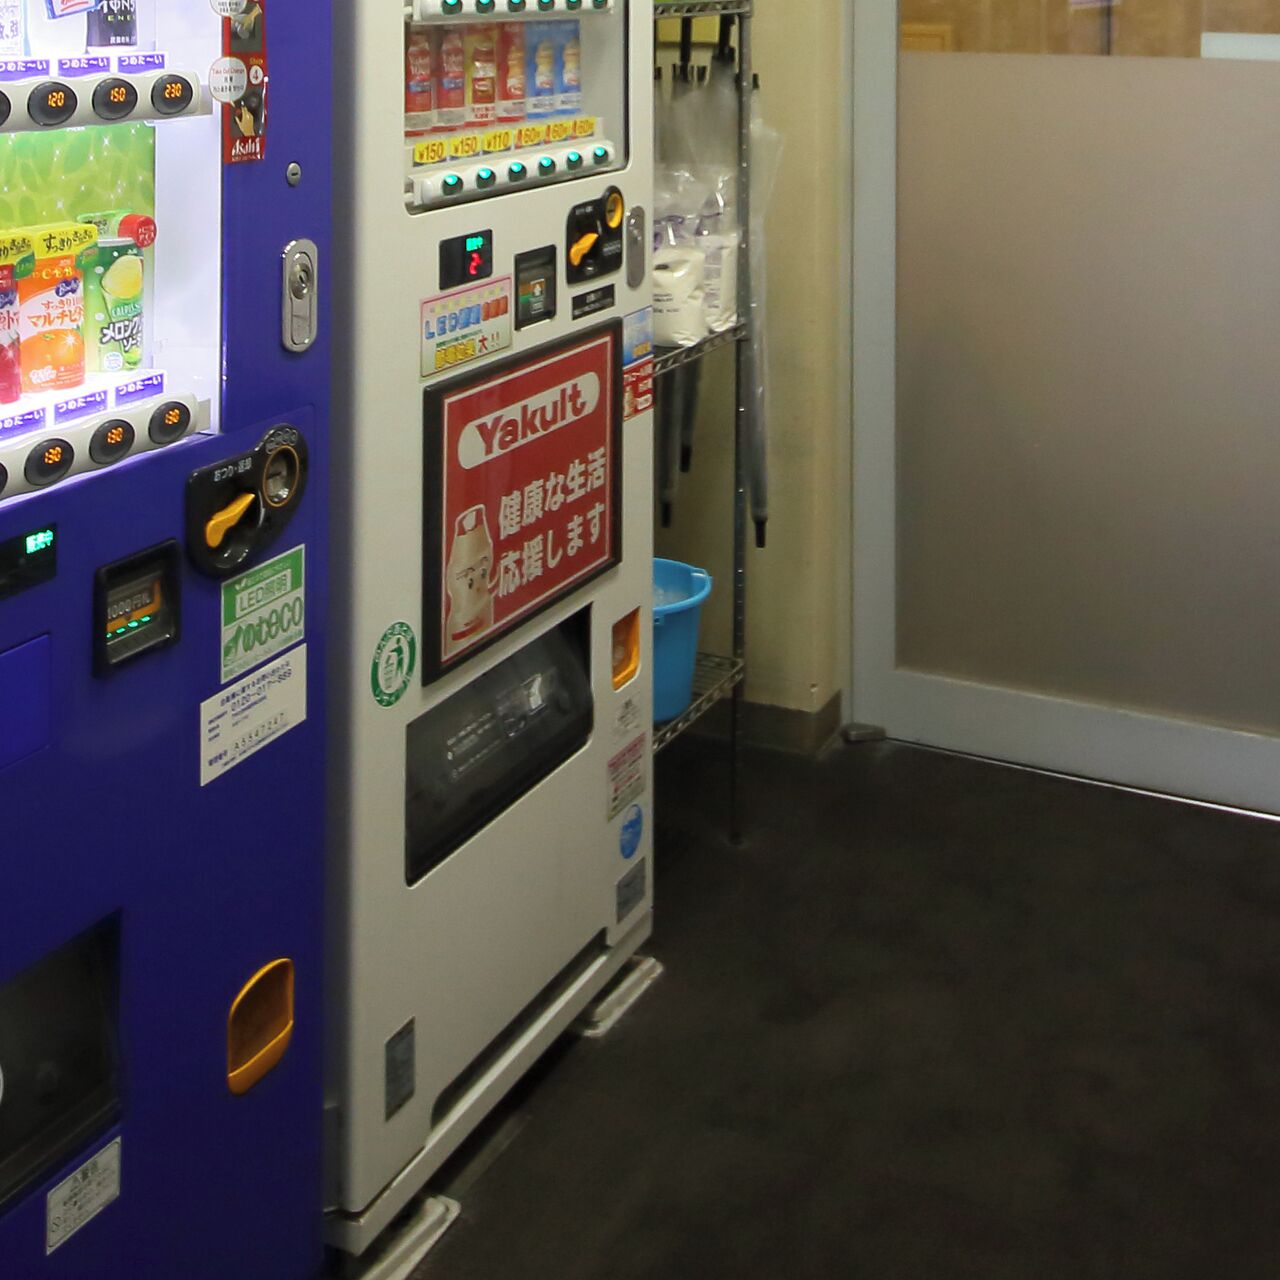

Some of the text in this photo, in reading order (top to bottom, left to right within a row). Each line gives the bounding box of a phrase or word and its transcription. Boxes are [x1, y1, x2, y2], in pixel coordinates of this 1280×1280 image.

[47, 92, 65, 107] 120
[110, 87, 126, 102] 150
[163, 82, 182, 97] 230
[474, 386, 589, 457] Yakult
[497, 447, 606, 540] 健康な生活
[497, 502, 605, 598] 応援します
